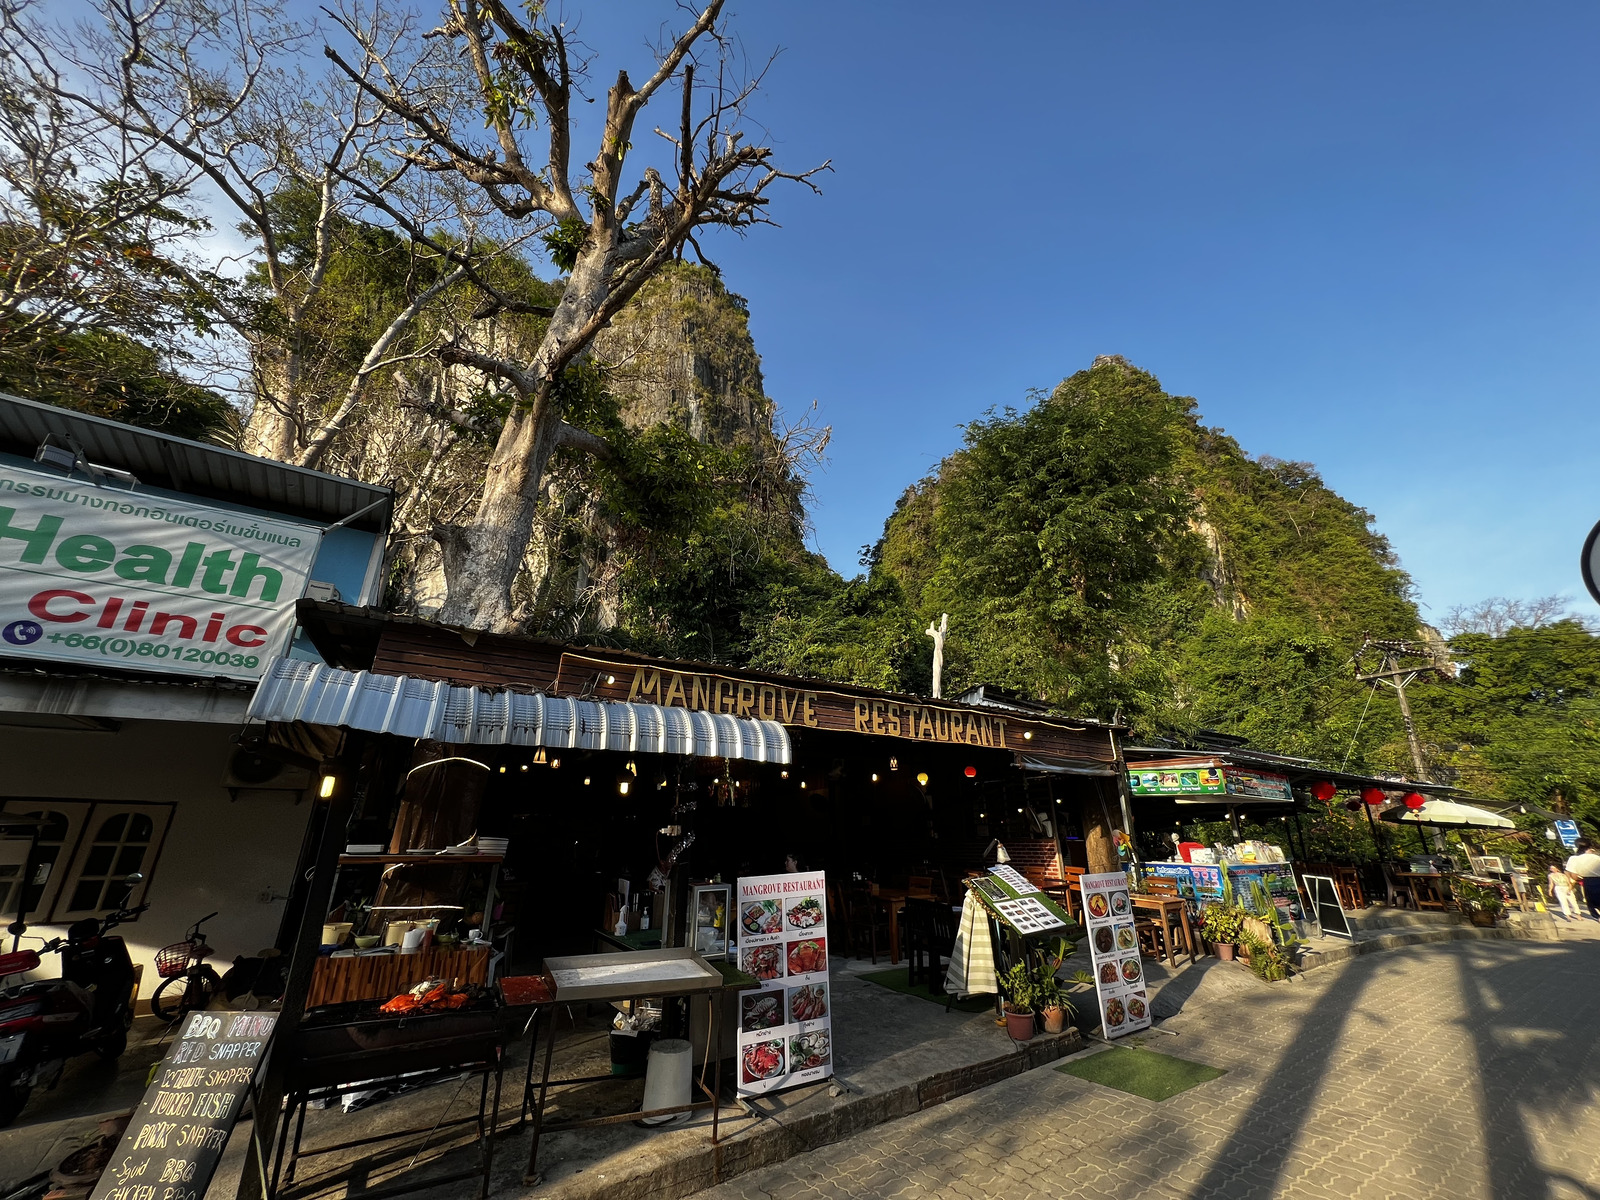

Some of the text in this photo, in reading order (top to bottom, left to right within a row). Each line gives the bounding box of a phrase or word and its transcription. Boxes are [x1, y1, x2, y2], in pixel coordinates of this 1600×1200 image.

[0, 505, 283, 602] Health
[27, 589, 268, 648] Clinic
[46, 632, 260, 669] +66(0)80120039
[628, 668, 1008, 748] MANGROVE RESTAURANT
[742, 879, 824, 896] MANGROVE RESTAURANT
[182, 1014, 221, 1039] BBQ
[172, 1041, 261, 1064] RED SNAPPER
[205, 1067, 253, 1087] SNAPPER
[149, 1091, 236, 1119] TUNA FISH
[159, 1158, 197, 1183] BBQ
